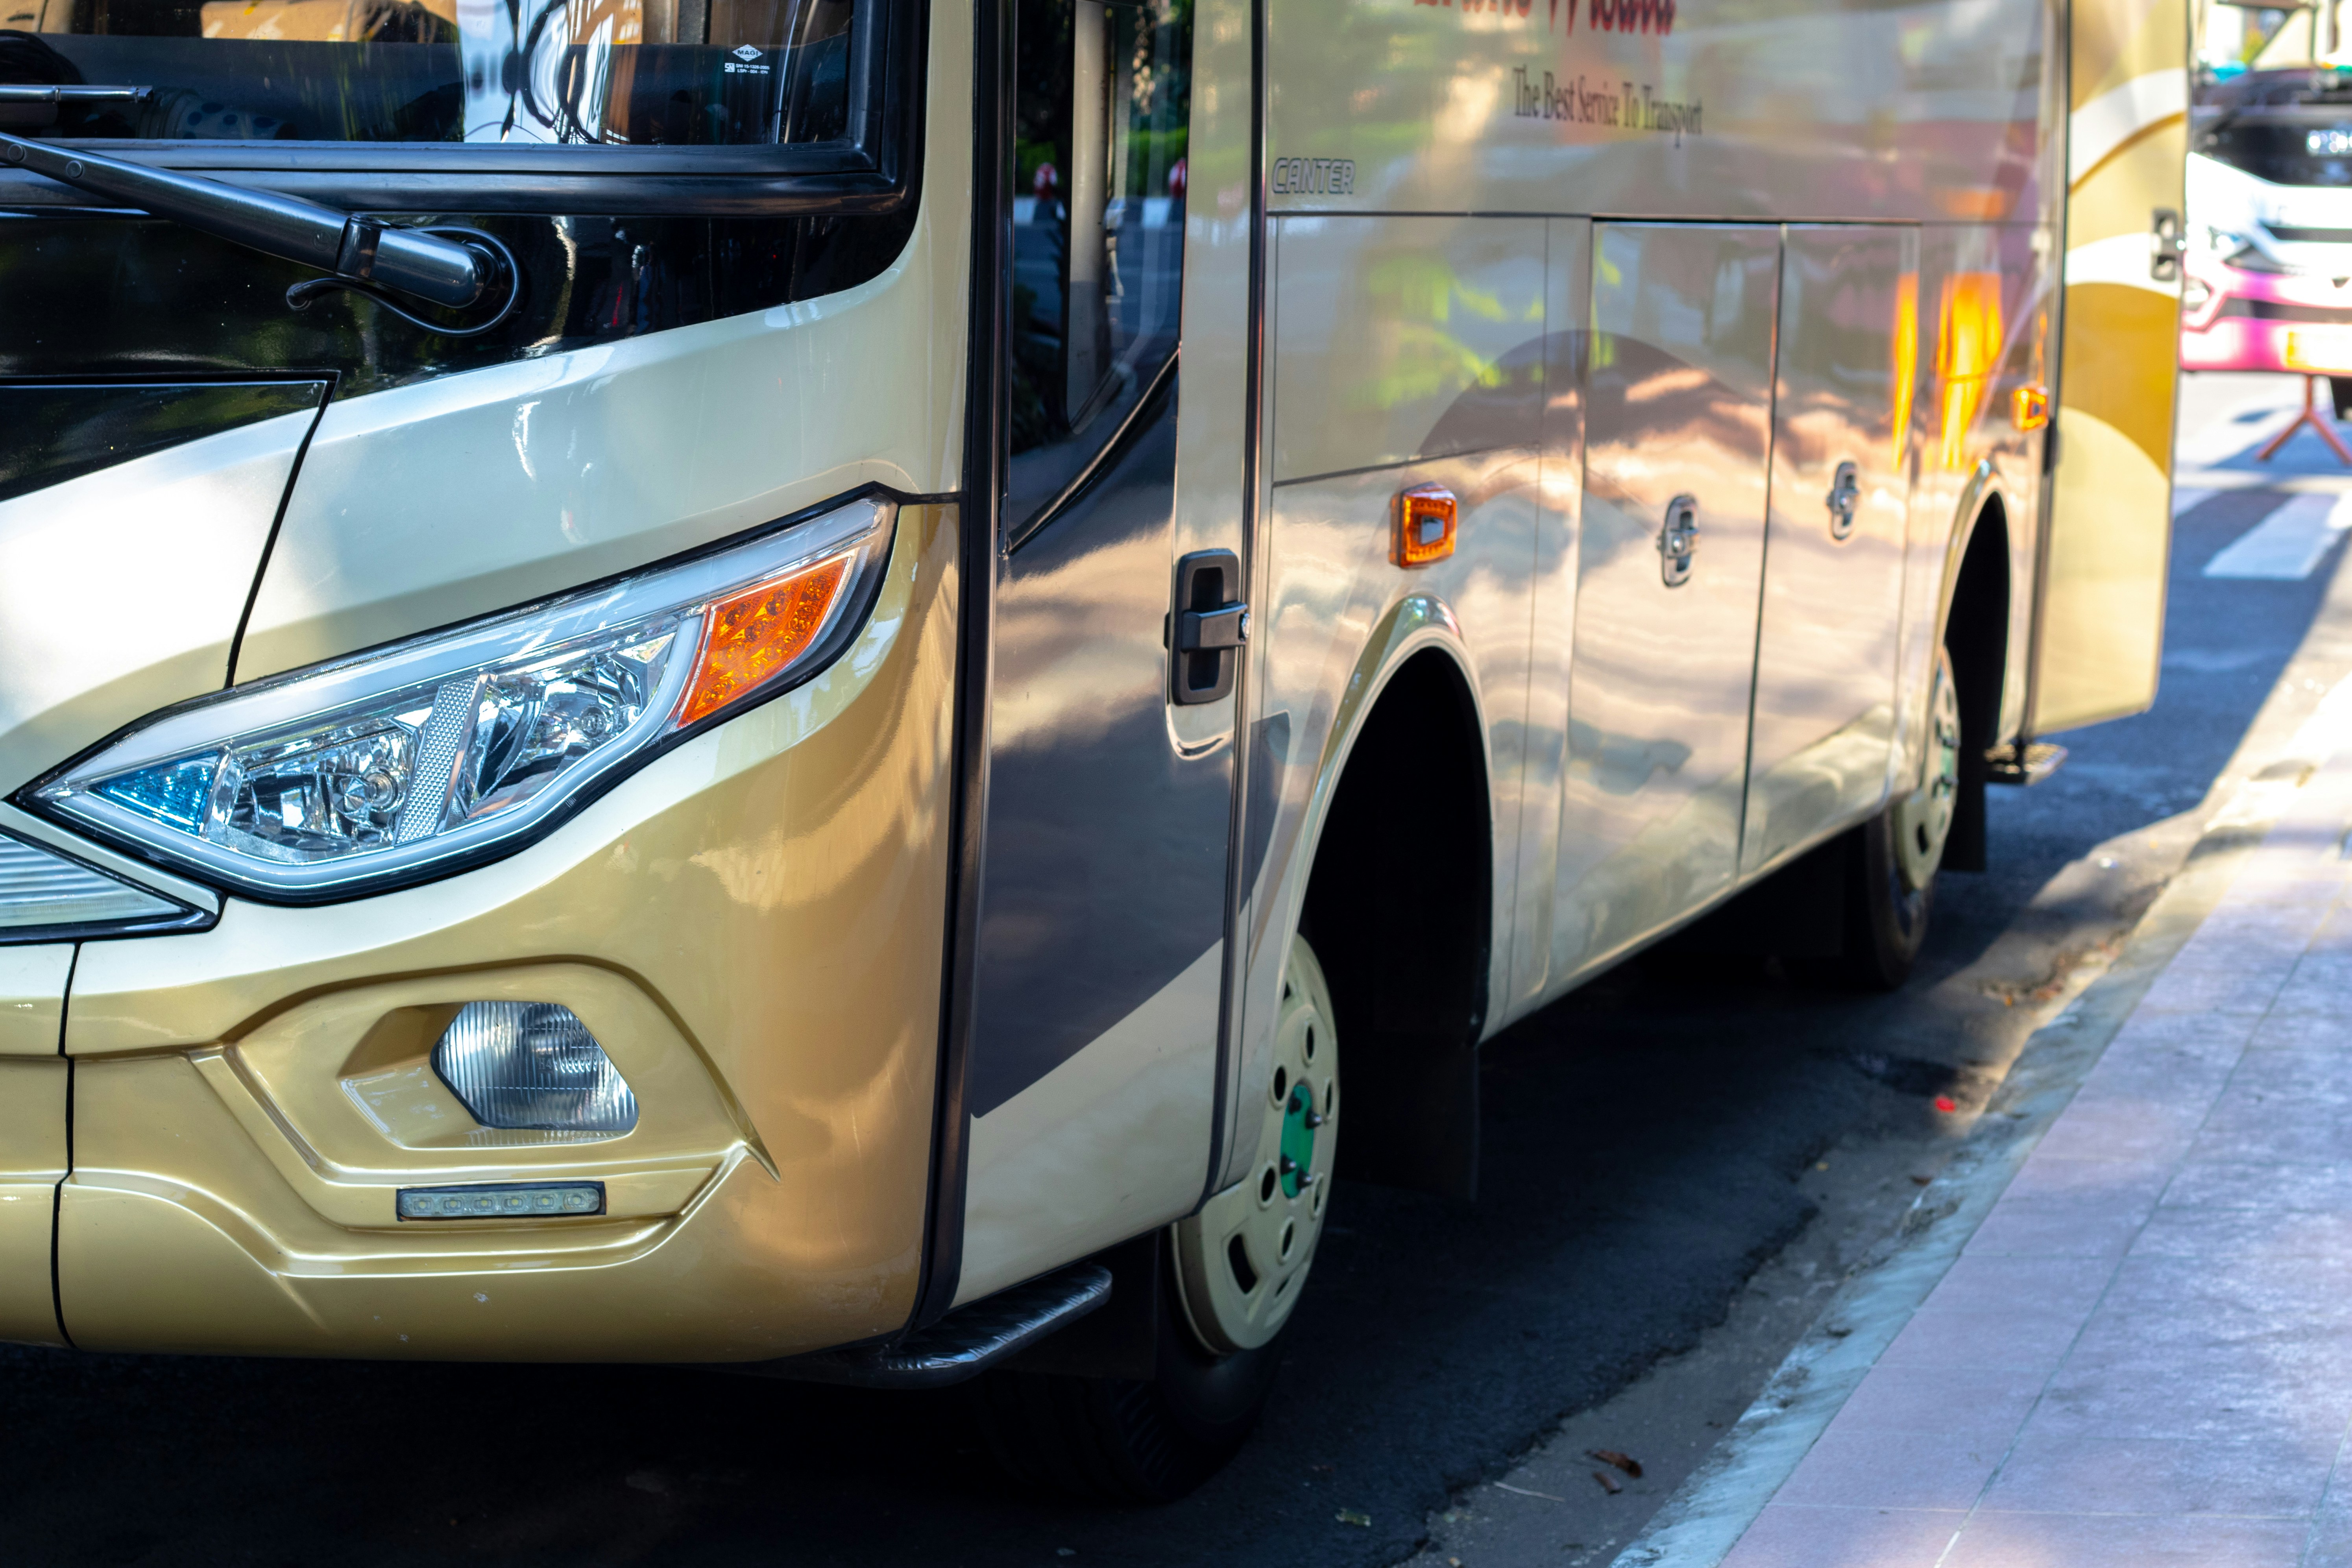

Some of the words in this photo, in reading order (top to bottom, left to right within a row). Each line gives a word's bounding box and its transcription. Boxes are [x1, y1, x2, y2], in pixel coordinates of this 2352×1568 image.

[1512, 64, 1540, 118] The
[1544, 70, 1574, 121] Best
[1578, 74, 1619, 126] Service
[1622, 81, 1639, 128] To
[1641, 84, 1703, 150] Transport
[1272, 157, 1355, 194] CANTER
